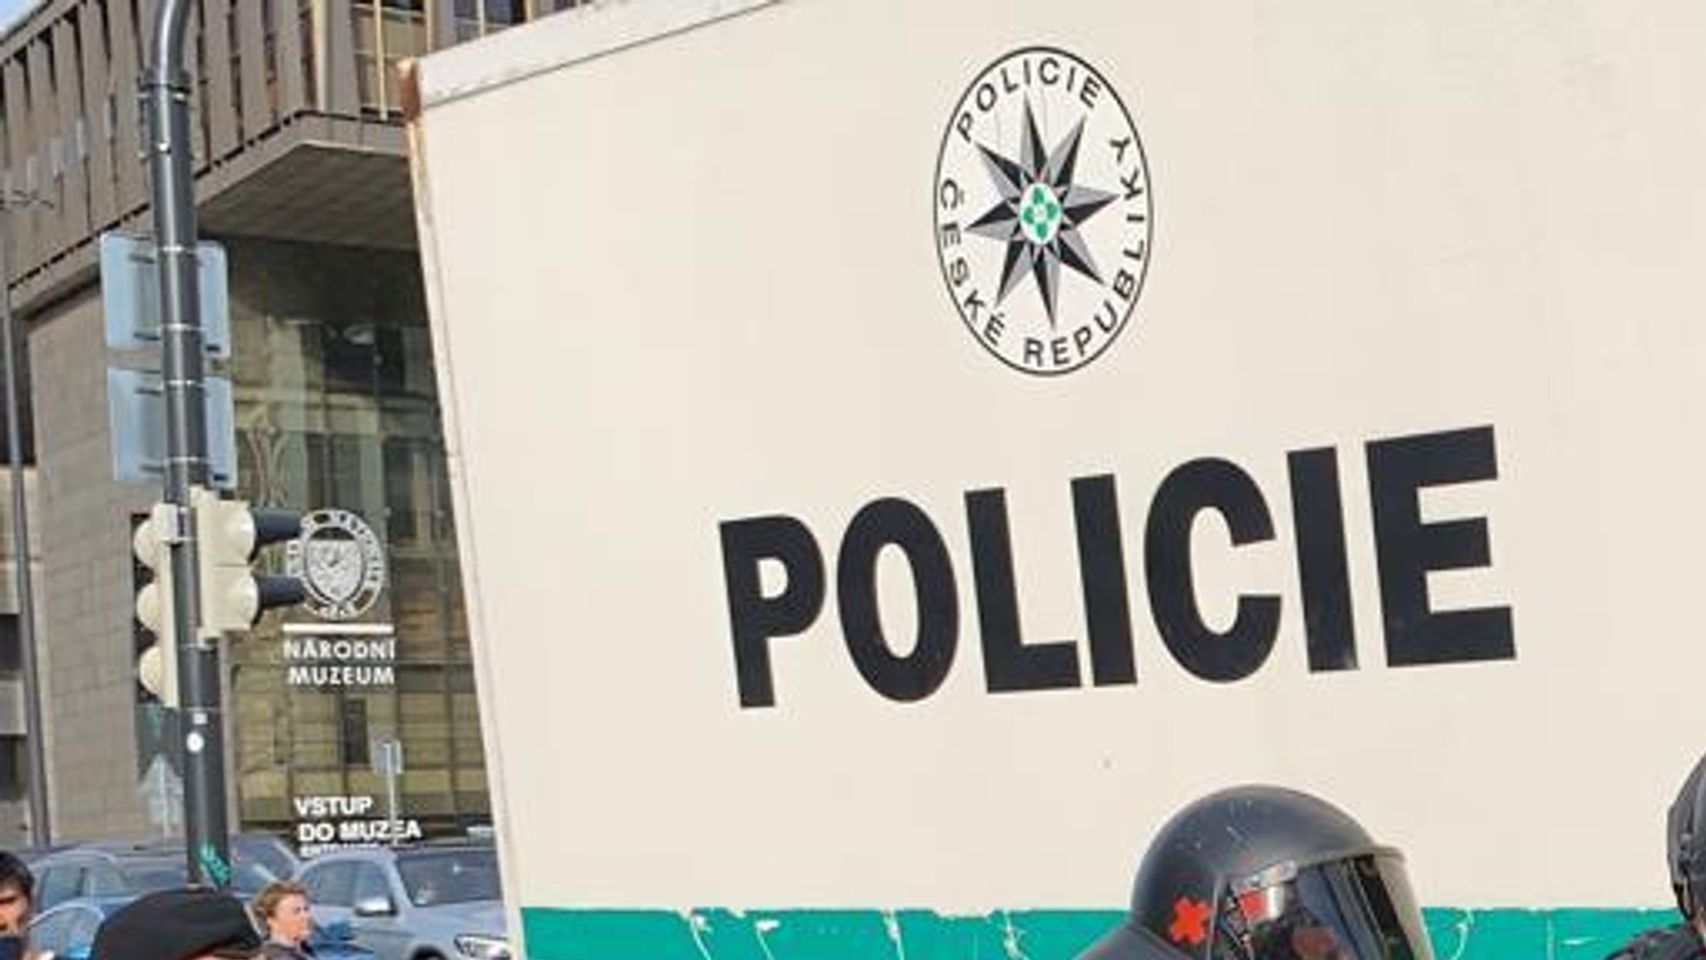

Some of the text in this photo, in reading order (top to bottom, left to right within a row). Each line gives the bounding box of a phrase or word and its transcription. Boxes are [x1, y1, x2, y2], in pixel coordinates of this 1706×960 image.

[956, 56, 1102, 143] POLICIE
[939, 135, 1148, 368] ČESKÉ REPUBLIKY
[718, 425, 1517, 708] POLICIE
[287, 665, 396, 686] MUZEUM
[293, 795, 374, 817] VSTUP
[298, 819, 422, 842] DO MUZEA
